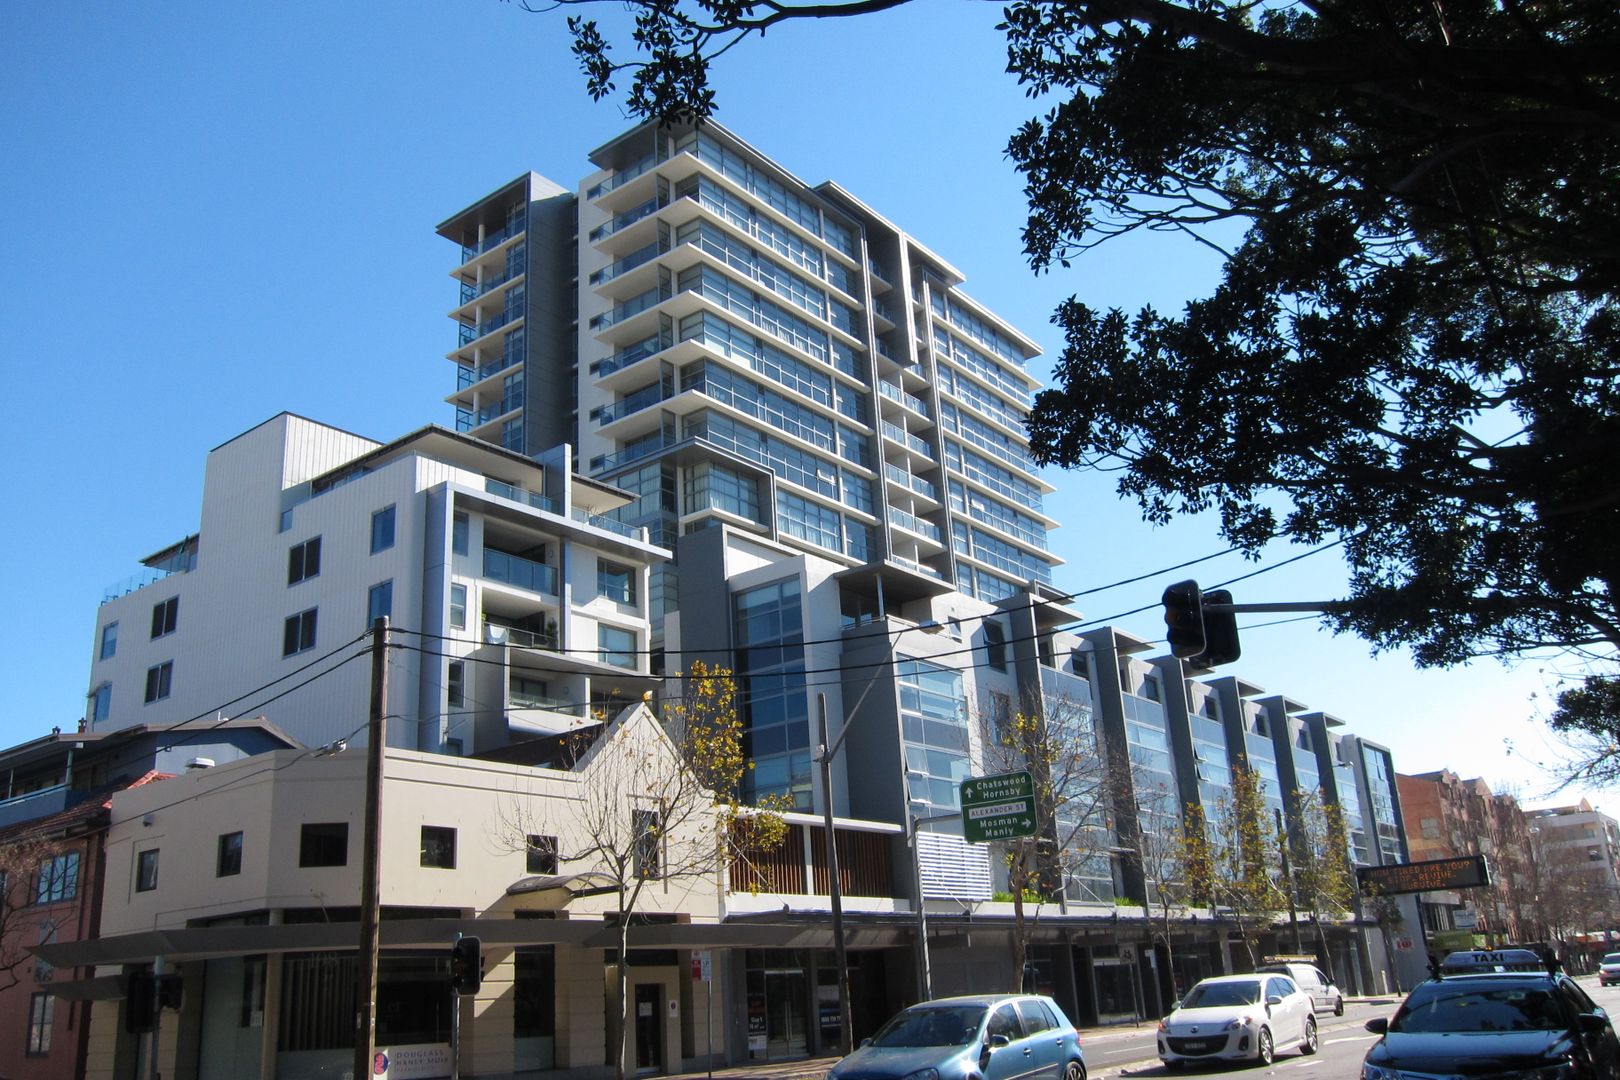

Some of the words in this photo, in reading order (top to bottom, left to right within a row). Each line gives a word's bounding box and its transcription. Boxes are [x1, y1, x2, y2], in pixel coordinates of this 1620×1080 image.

[976, 776, 1026, 790] Chatswood
[983, 787, 1020, 799] Hornsby
[971, 806, 1013, 817] ALEXANDER
[980, 817, 1018, 828] Mosman
[985, 827, 1014, 837] Manly
[1424, 863, 1441, 872] ARE
[1445, 860, 1473, 871] YOU?
[1472, 953, 1504, 963] TAXI
[396, 1050, 445, 1058] DOUGLASS
